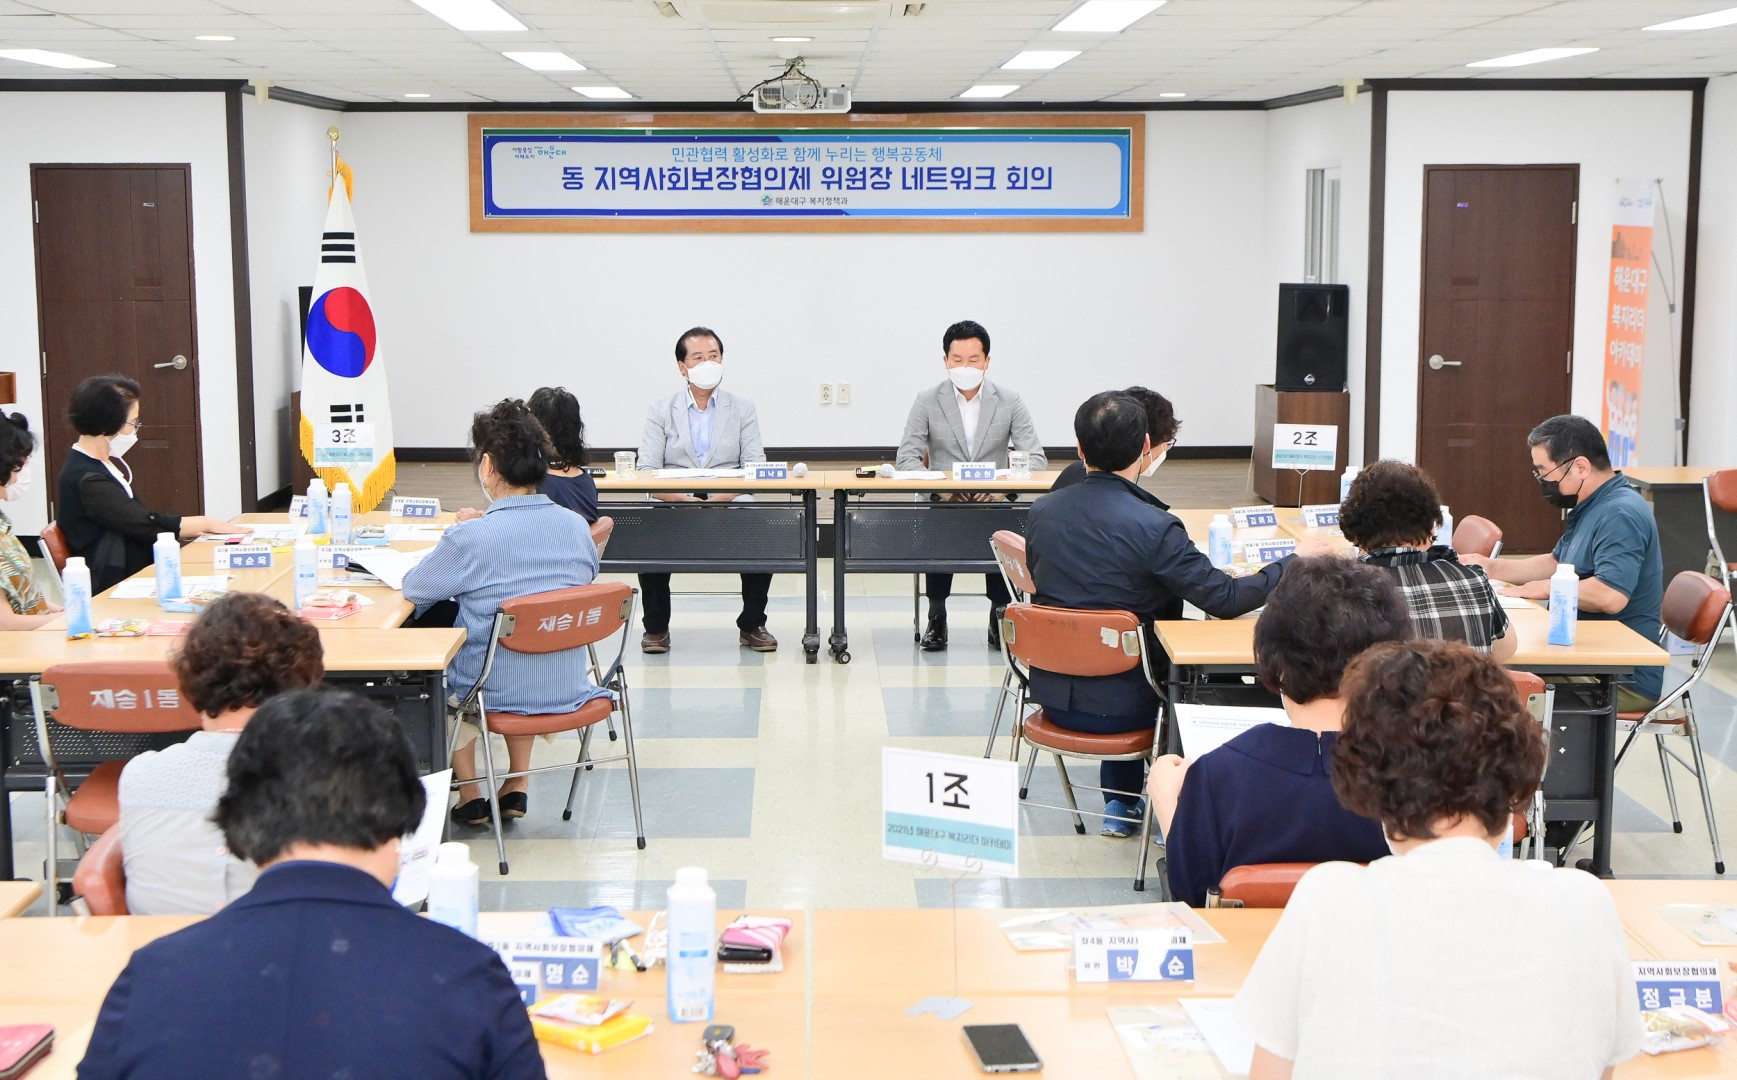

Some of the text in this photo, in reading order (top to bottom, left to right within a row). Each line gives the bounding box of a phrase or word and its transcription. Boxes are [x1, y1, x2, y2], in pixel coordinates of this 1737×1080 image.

[672, 146, 943, 163] 민관협력 활성화로 함께 누리는 행복공동체
[561, 166, 1053, 191] 동 지역사회보장협의체 위원장 네트워크 회의
[775, 196, 848, 206] 해운대구 복지정책과
[1613, 265, 1648, 296] 해운대구
[1611, 303, 1645, 335] 복지리더
[1609, 339, 1643, 370] 아카데미
[332, 428, 357, 444] 3조
[1292, 430, 1318, 446] 2조
[926, 772, 971, 810] 1조
[887, 823, 914, 836] 2021년
[915, 826, 946, 840] 해운대구
[981, 836, 1012, 850] 아카데미
[546, 963, 590, 985] 명순
[1638, 966, 1717, 976] 지역사회보장협의체
[1642, 987, 1713, 1009] 정금분
